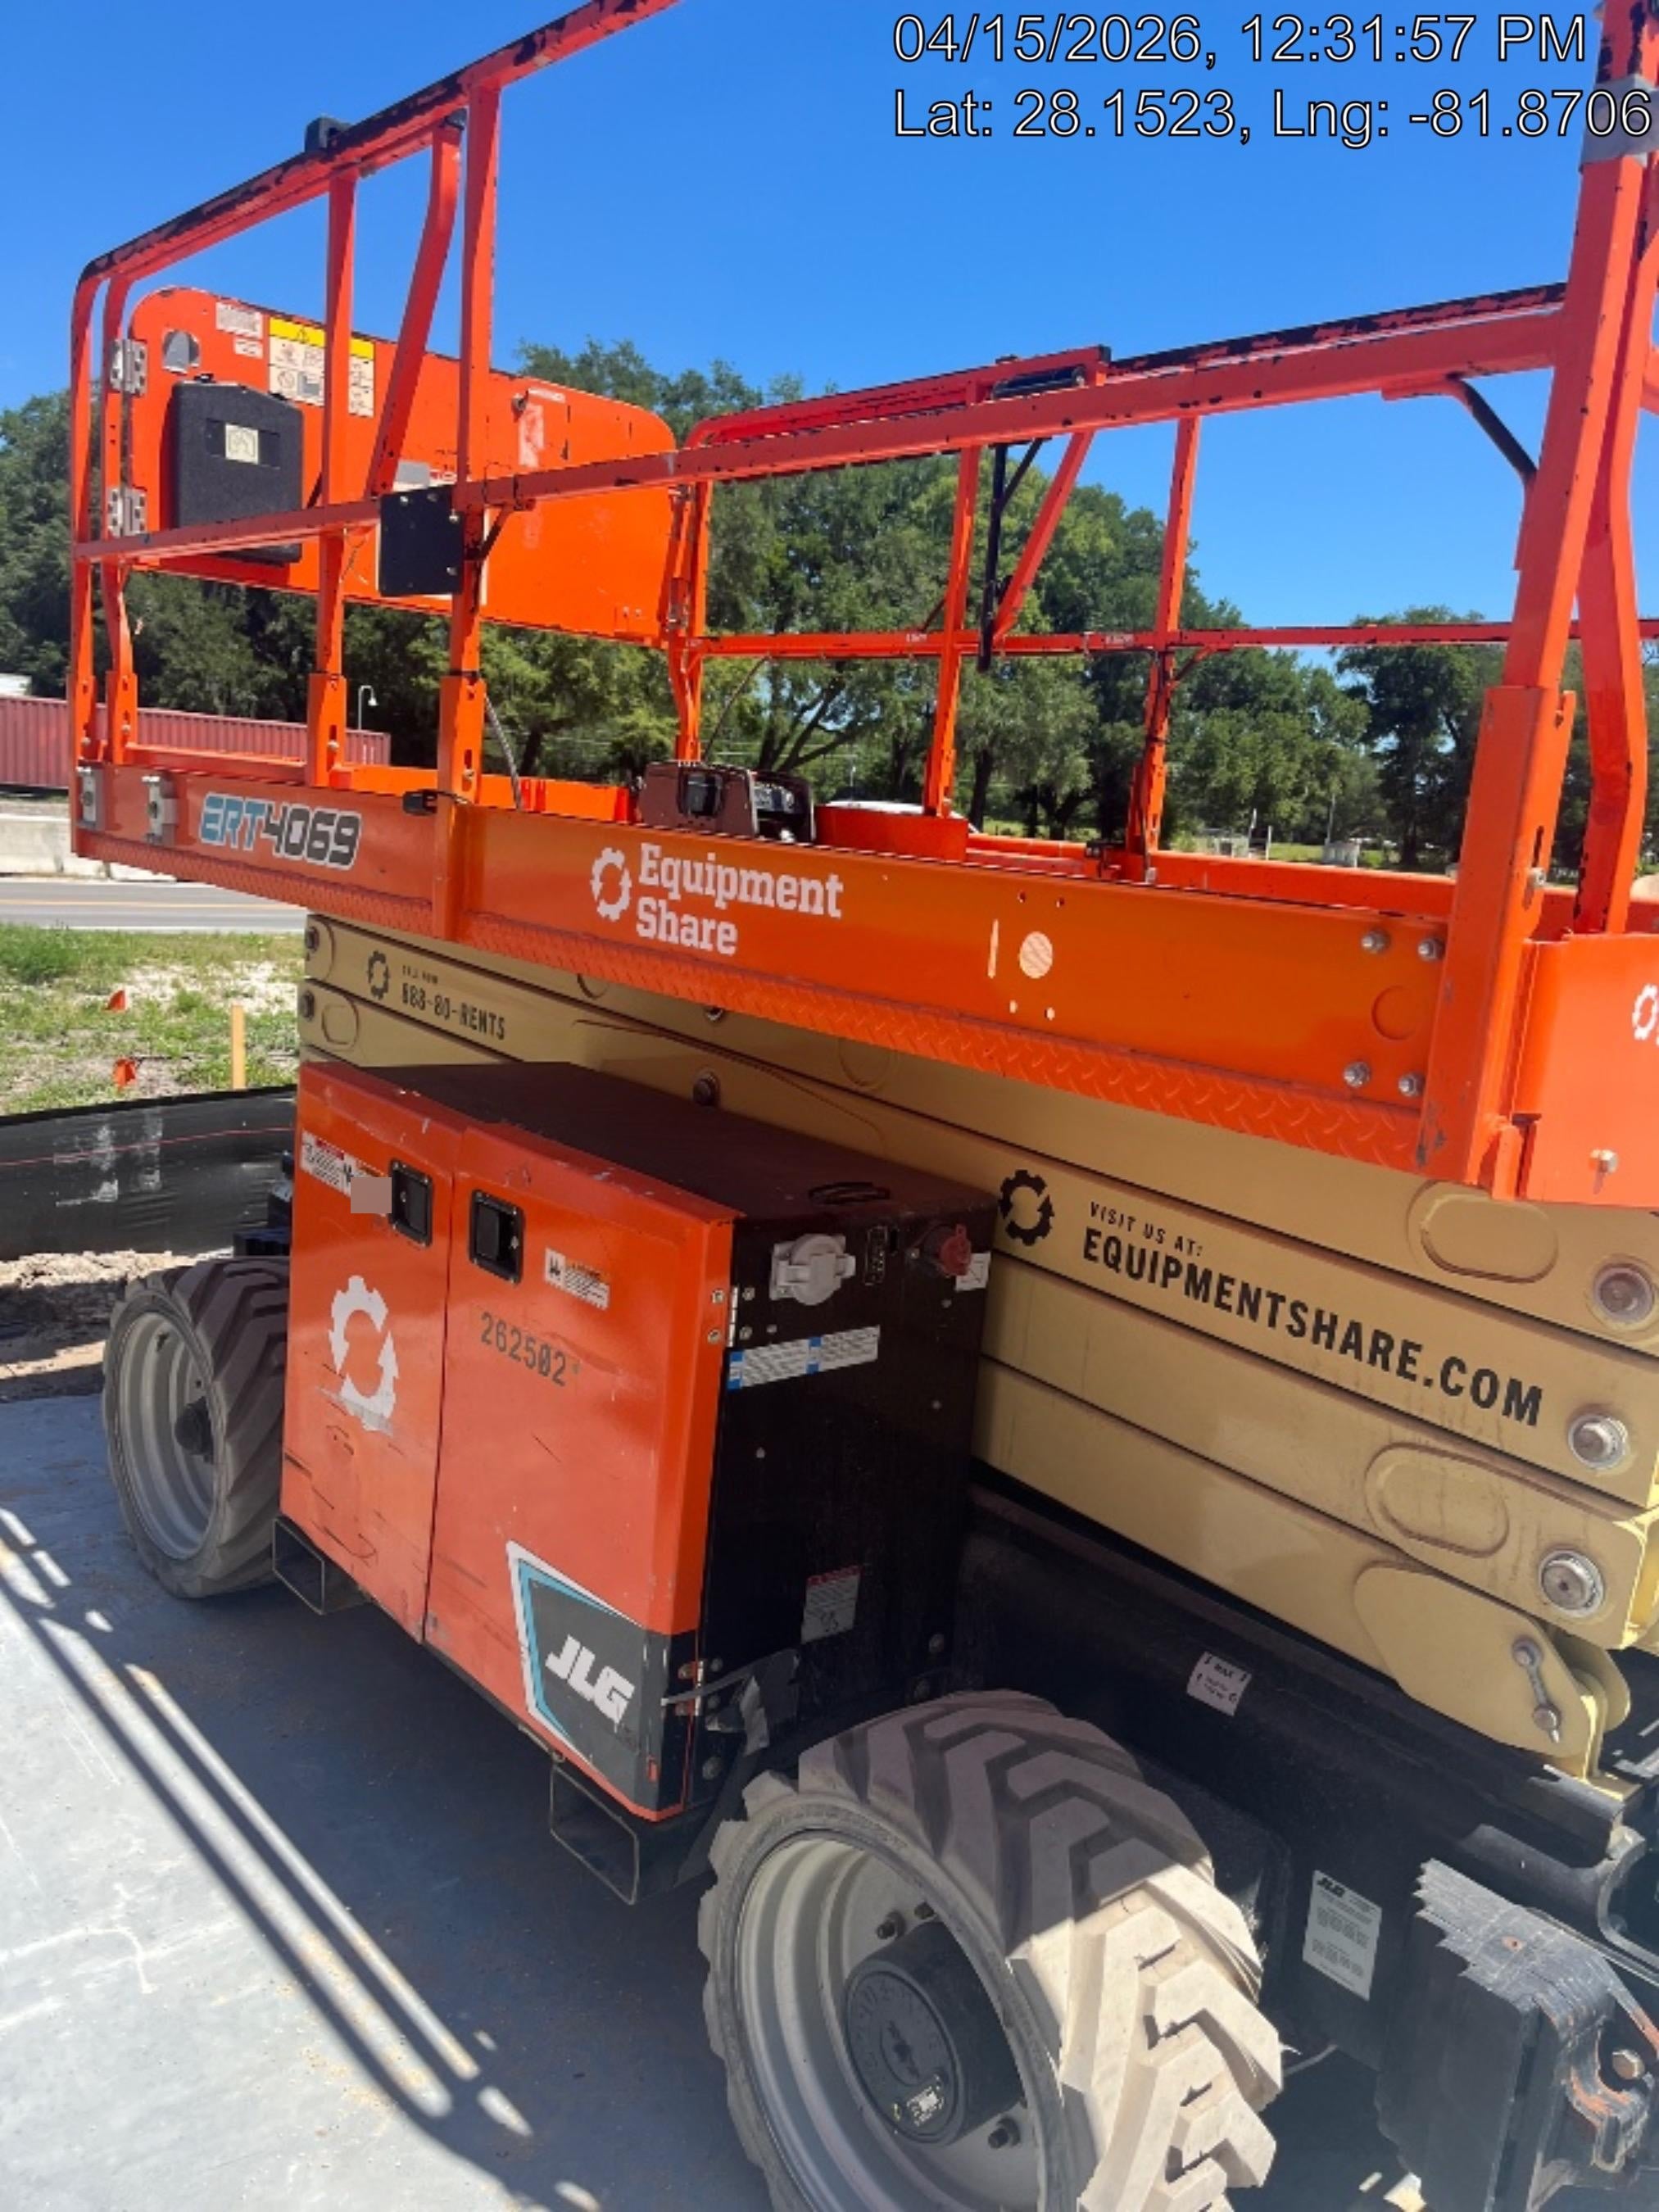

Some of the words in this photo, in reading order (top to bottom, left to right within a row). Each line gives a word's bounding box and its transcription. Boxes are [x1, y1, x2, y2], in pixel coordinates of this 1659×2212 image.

[199, 791, 362, 871] ERT4069
[640, 842, 844, 918] Equipment
[636, 897, 738, 955] Share
[1090, 1201, 1136, 1232] VISIT
[1144, 1222, 1167, 1244] US
[481, 1311, 566, 1388] 262502
[1083, 1226, 1543, 1427] EQUIPMENTSHARE.COM
[544, 1633, 636, 1725] JLG
